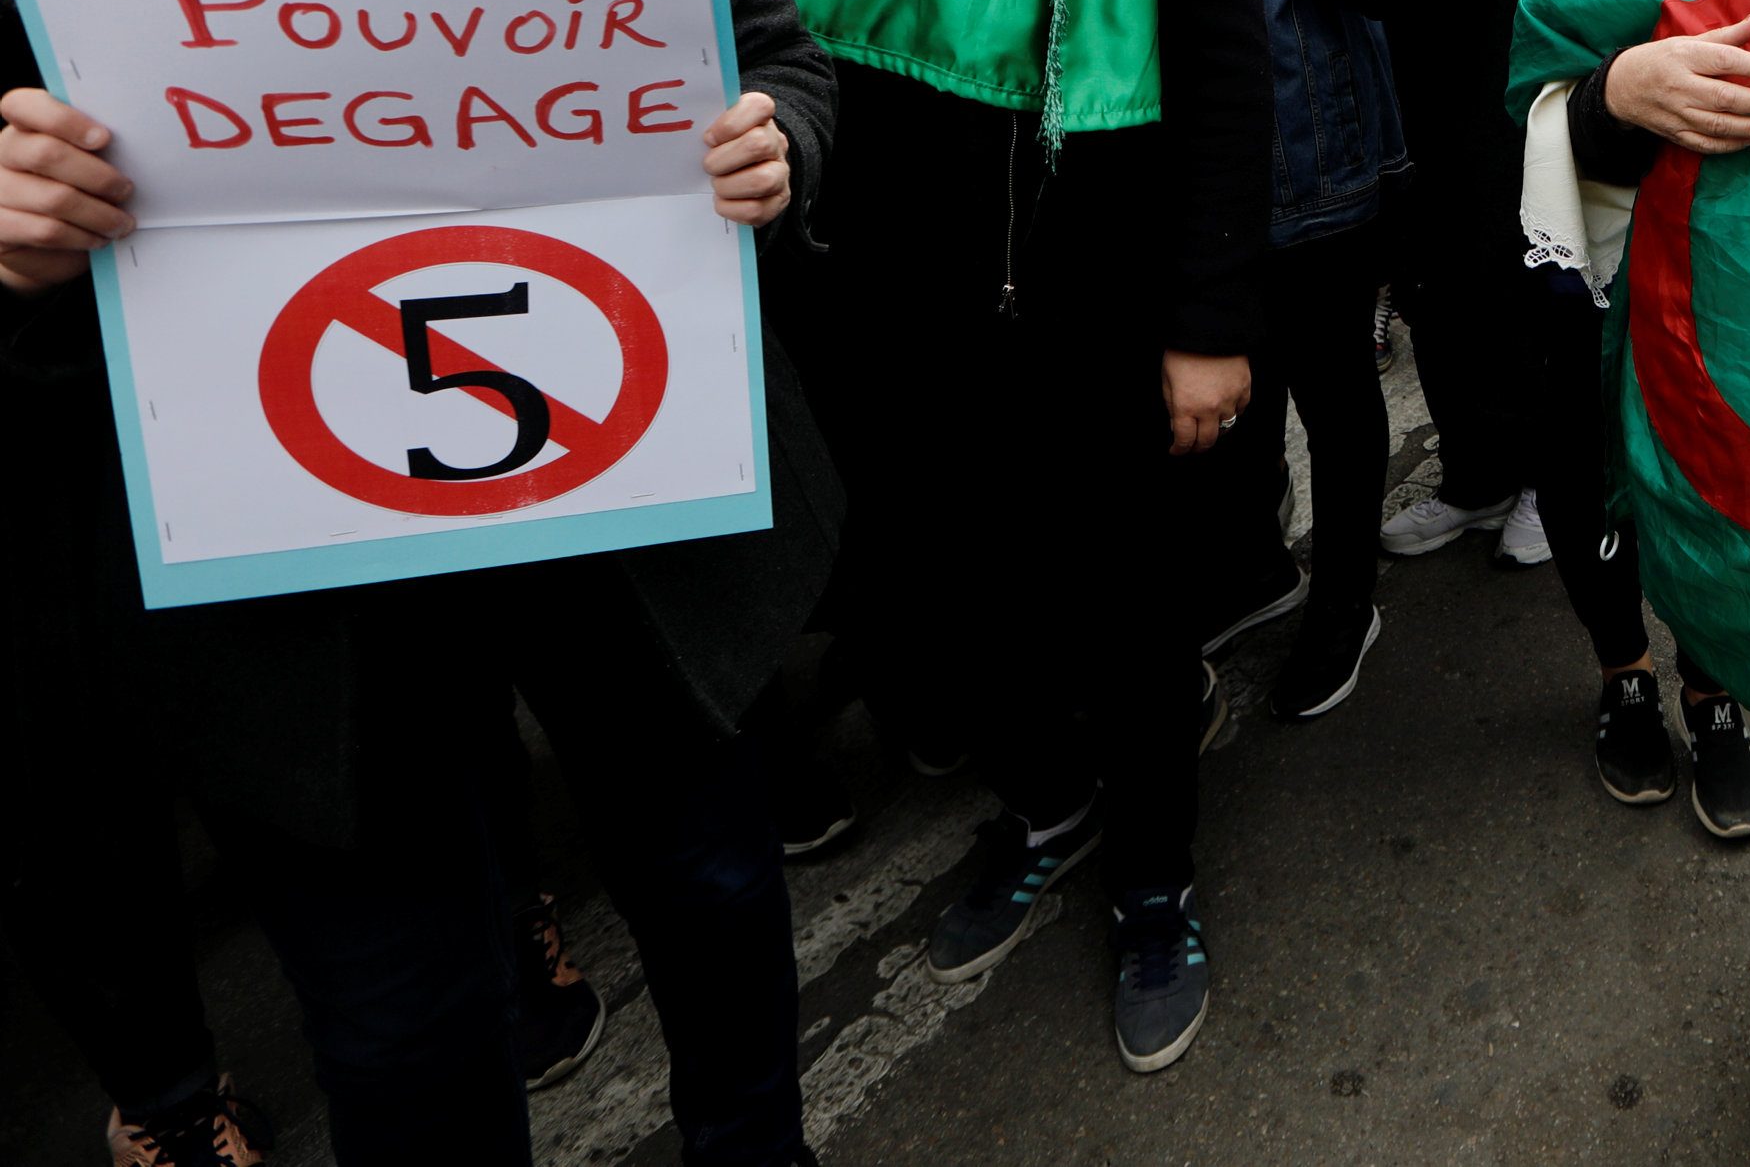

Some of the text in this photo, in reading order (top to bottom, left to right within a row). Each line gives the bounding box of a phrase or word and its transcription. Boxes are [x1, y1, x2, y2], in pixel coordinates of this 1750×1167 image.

[166, 78, 695, 152] DEGAGE
[400, 281, 551, 481] 5
[1621, 677, 1641, 699] M
[1713, 702, 1733, 724] M
